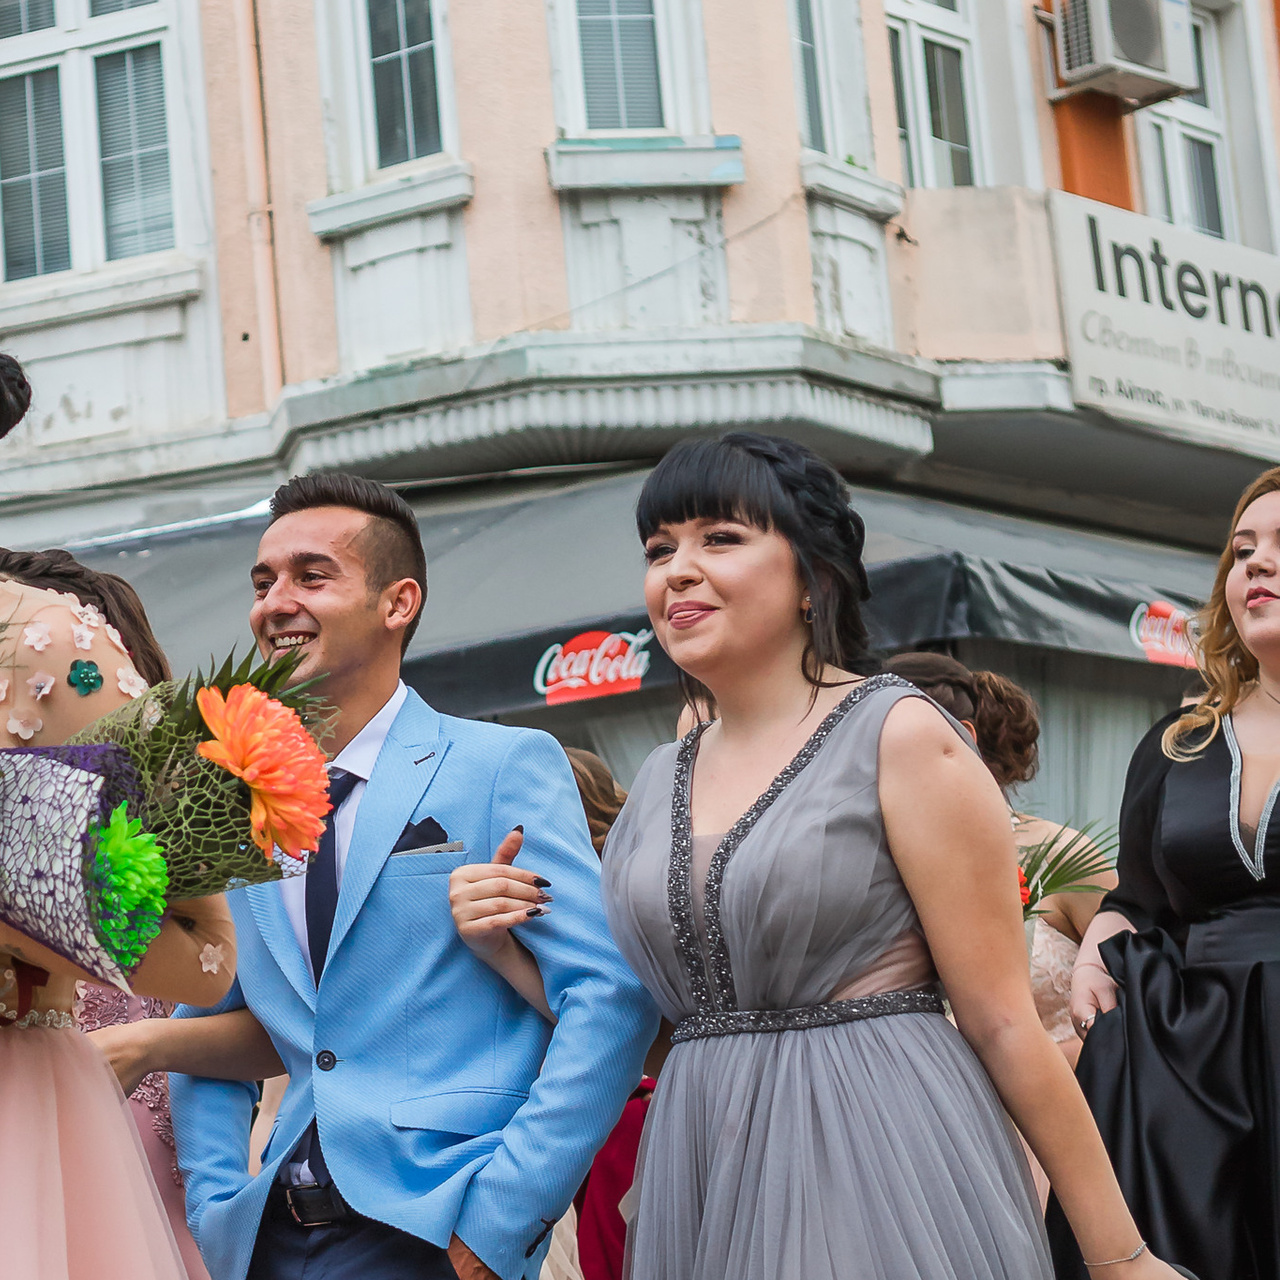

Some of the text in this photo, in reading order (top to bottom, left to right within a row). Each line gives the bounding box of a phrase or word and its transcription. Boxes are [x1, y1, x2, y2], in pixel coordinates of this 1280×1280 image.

[1087, 214, 1280, 338] Intern
[533, 629, 655, 695] Coca-Cola
[1129, 603, 1202, 657] Coca-Co
